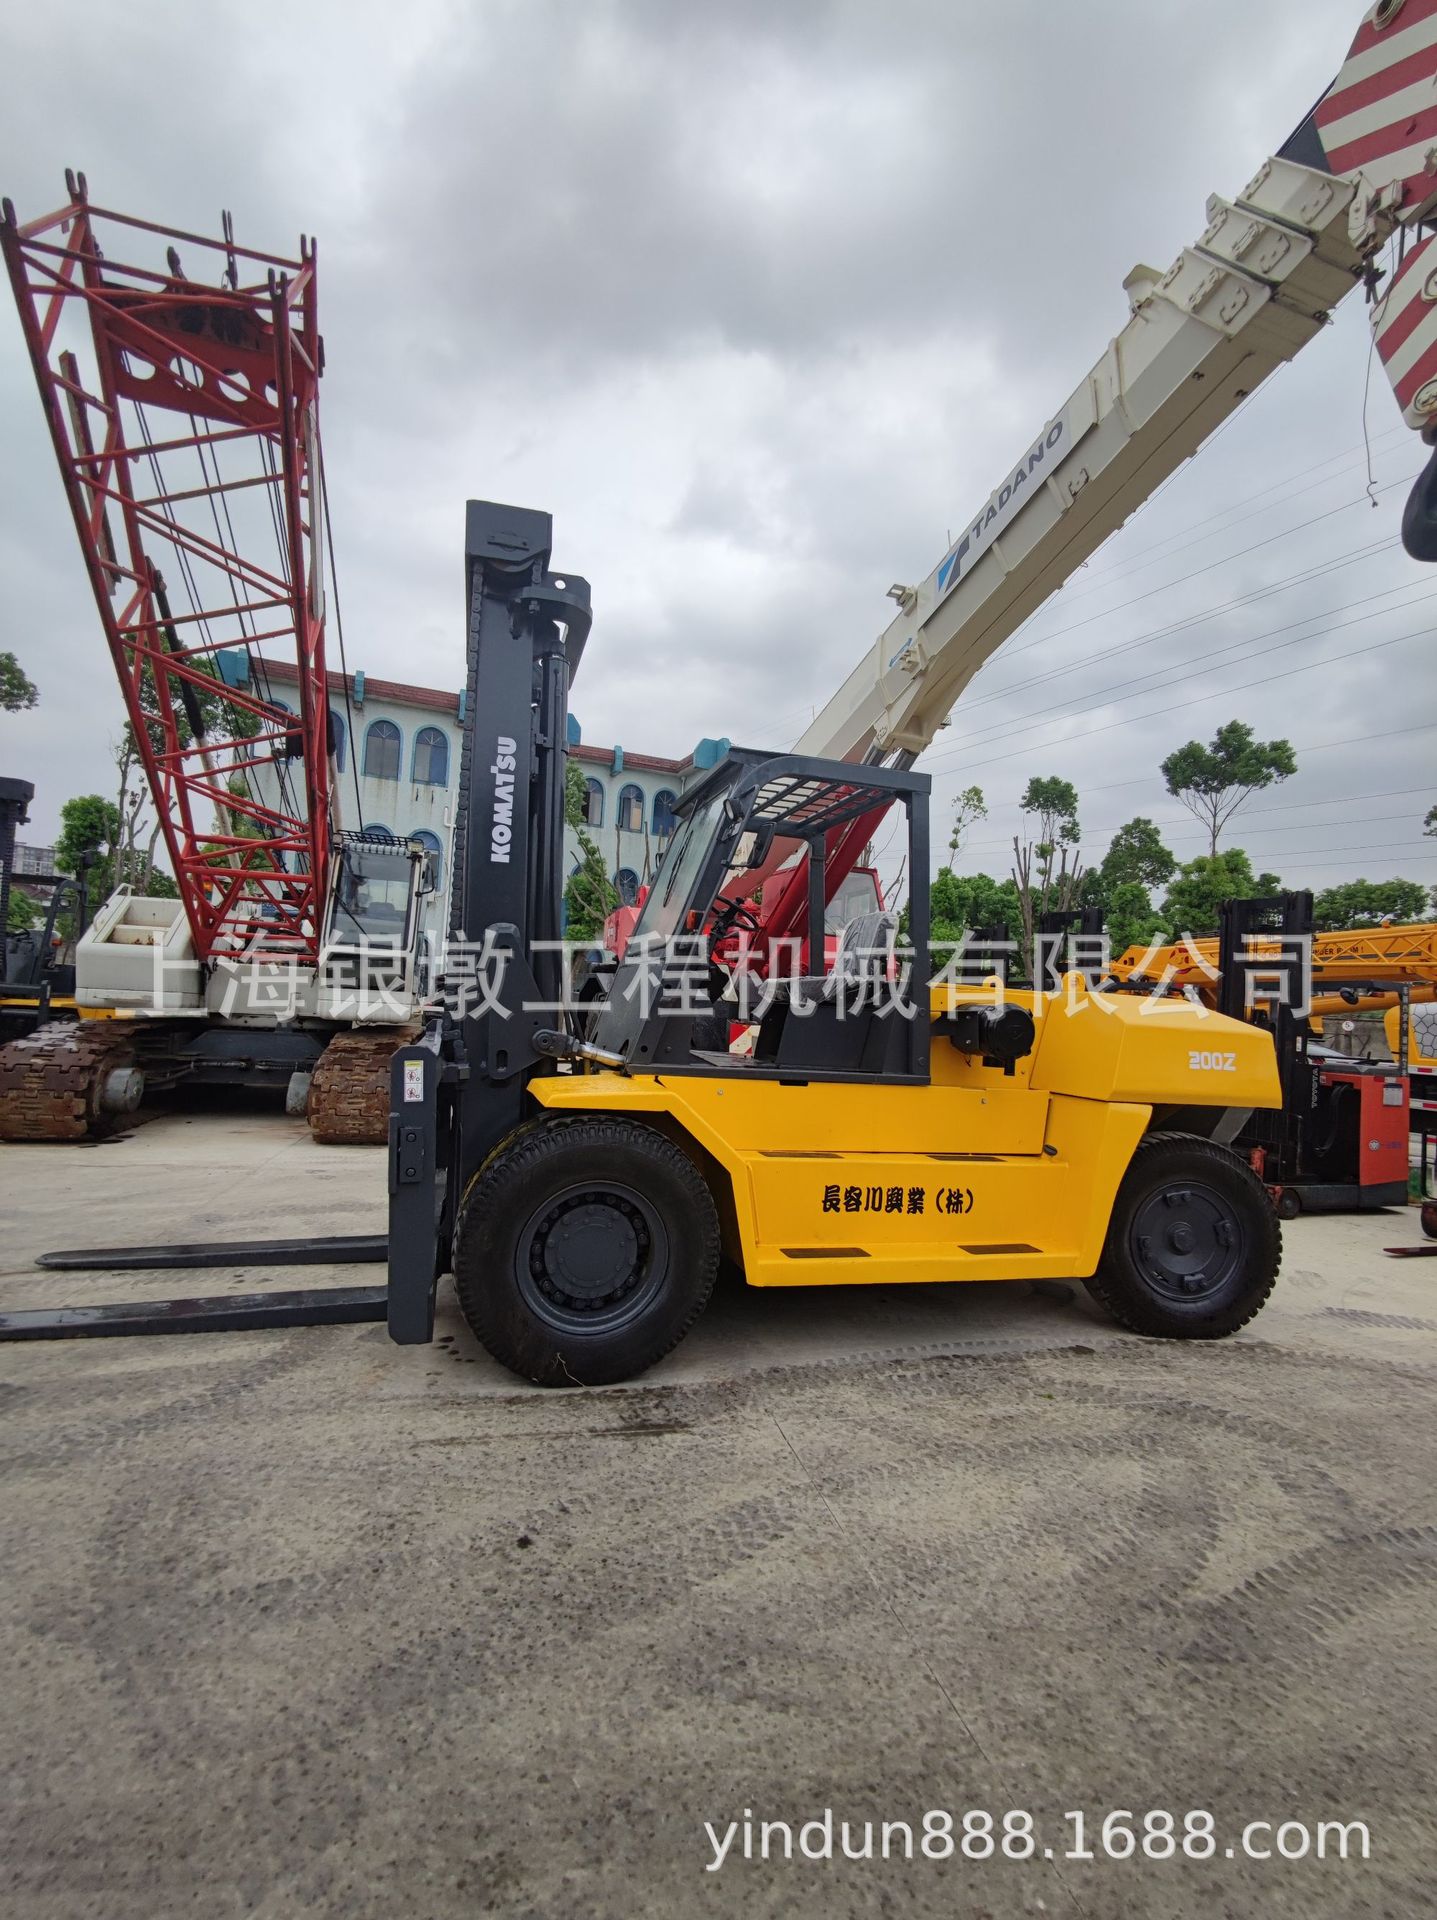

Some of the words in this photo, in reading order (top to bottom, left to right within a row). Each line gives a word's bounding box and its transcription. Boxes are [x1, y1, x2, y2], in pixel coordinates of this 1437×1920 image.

[971, 421, 1064, 540] TADANO
[490, 736, 517, 863] KOMATSU
[1188, 1051, 1237, 1072] 200Z
